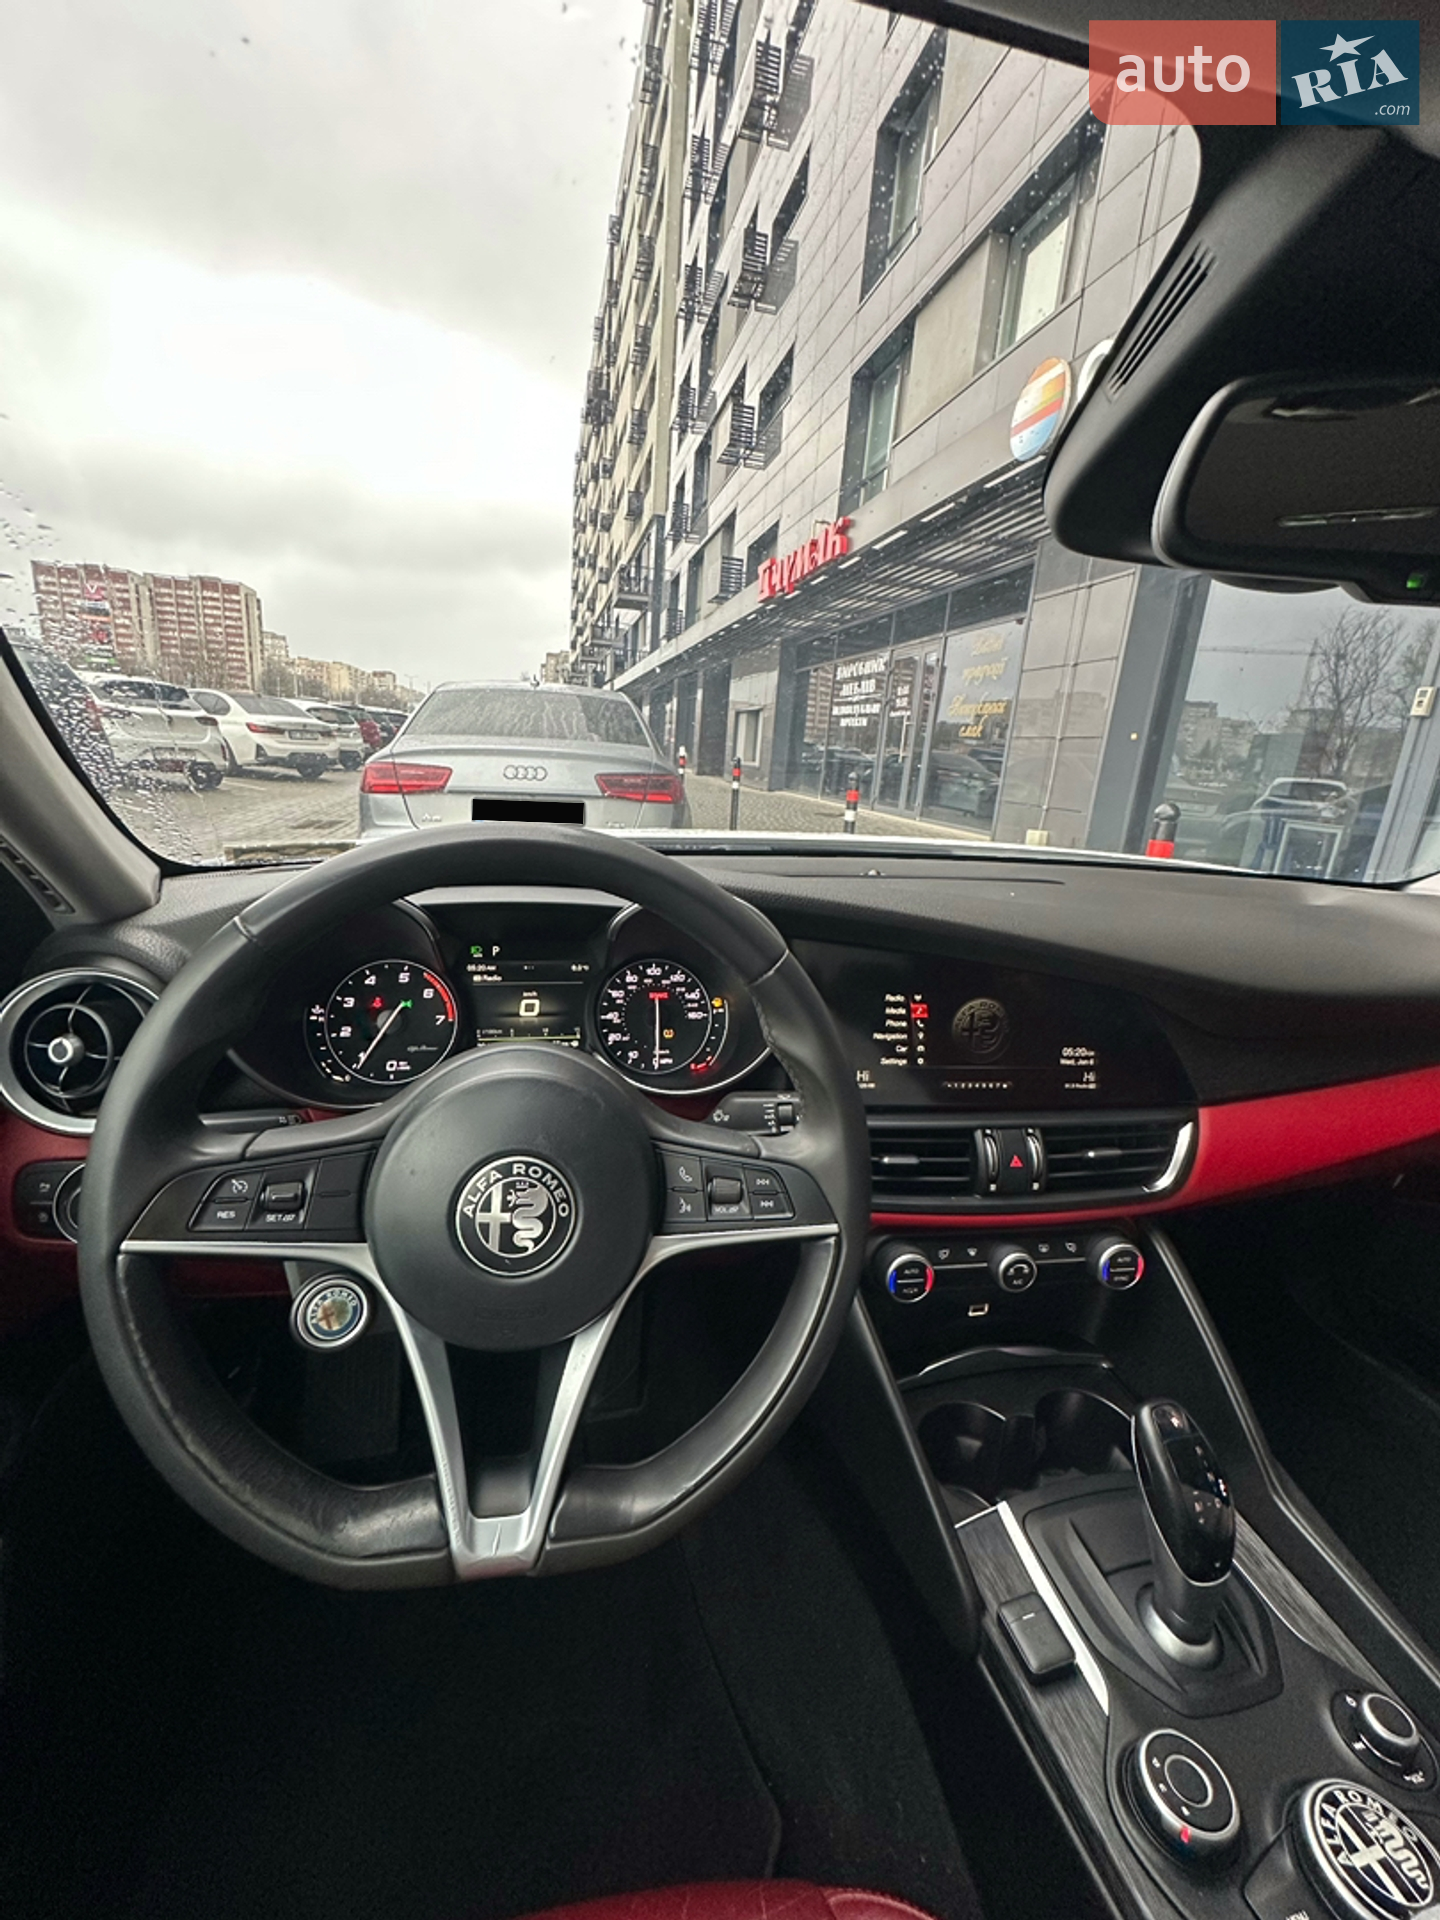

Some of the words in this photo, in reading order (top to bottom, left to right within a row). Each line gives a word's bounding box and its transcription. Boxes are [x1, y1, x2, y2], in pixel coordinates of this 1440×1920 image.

[492, 945, 500, 956] P
[646, 967, 662, 976] 100
[364, 975, 377, 986] 4
[398, 972, 410, 983] 5
[423, 988, 434, 999] 6
[884, 993, 905, 1002] Radio
[343, 997, 355, 1008] 3
[519, 998, 540, 1017] 0
[885, 1006, 907, 1015] Media
[435, 1015, 446, 1026] 7
[885, 1019, 908, 1027] Phone
[339, 1026, 352, 1038] 2
[872, 1032, 908, 1041] Navigation
[895, 1044, 908, 1052] Car
[880, 1057, 908, 1066] Settings
[856, 1070, 870, 1082] Hi
[462, 1169, 503, 1219] ALFA
[512, 1162, 570, 1218] ROMEO
[216, 1210, 236, 1219] RES
[1333, 1789, 1419, 1842] ROMEO
[1320, 1802, 1353, 1867] ALFA
